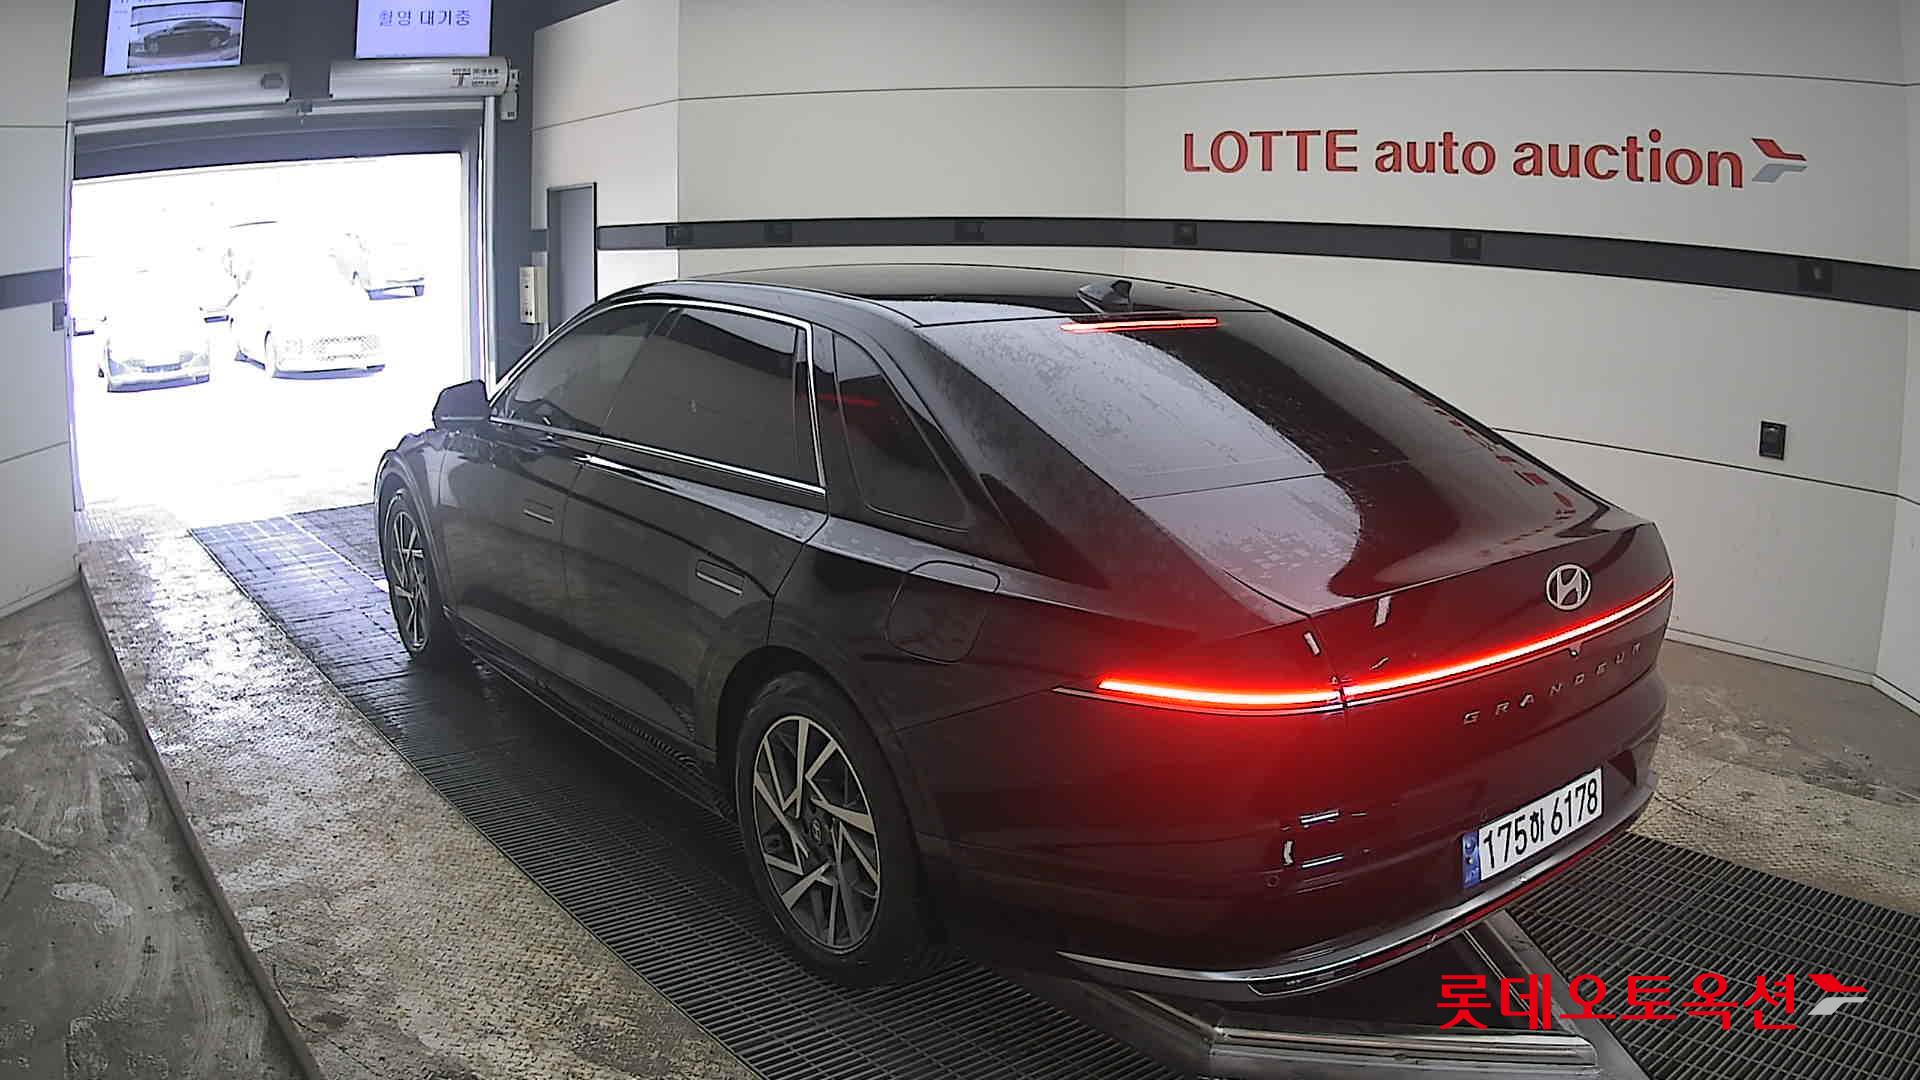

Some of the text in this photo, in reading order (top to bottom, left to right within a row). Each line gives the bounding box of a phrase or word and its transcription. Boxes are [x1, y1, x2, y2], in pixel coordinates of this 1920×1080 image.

[419, 9, 471, 26] 대기중
[1183, 128, 1743, 188] LOTTE auto auction
[1483, 777, 1598, 869] 175하 6178
